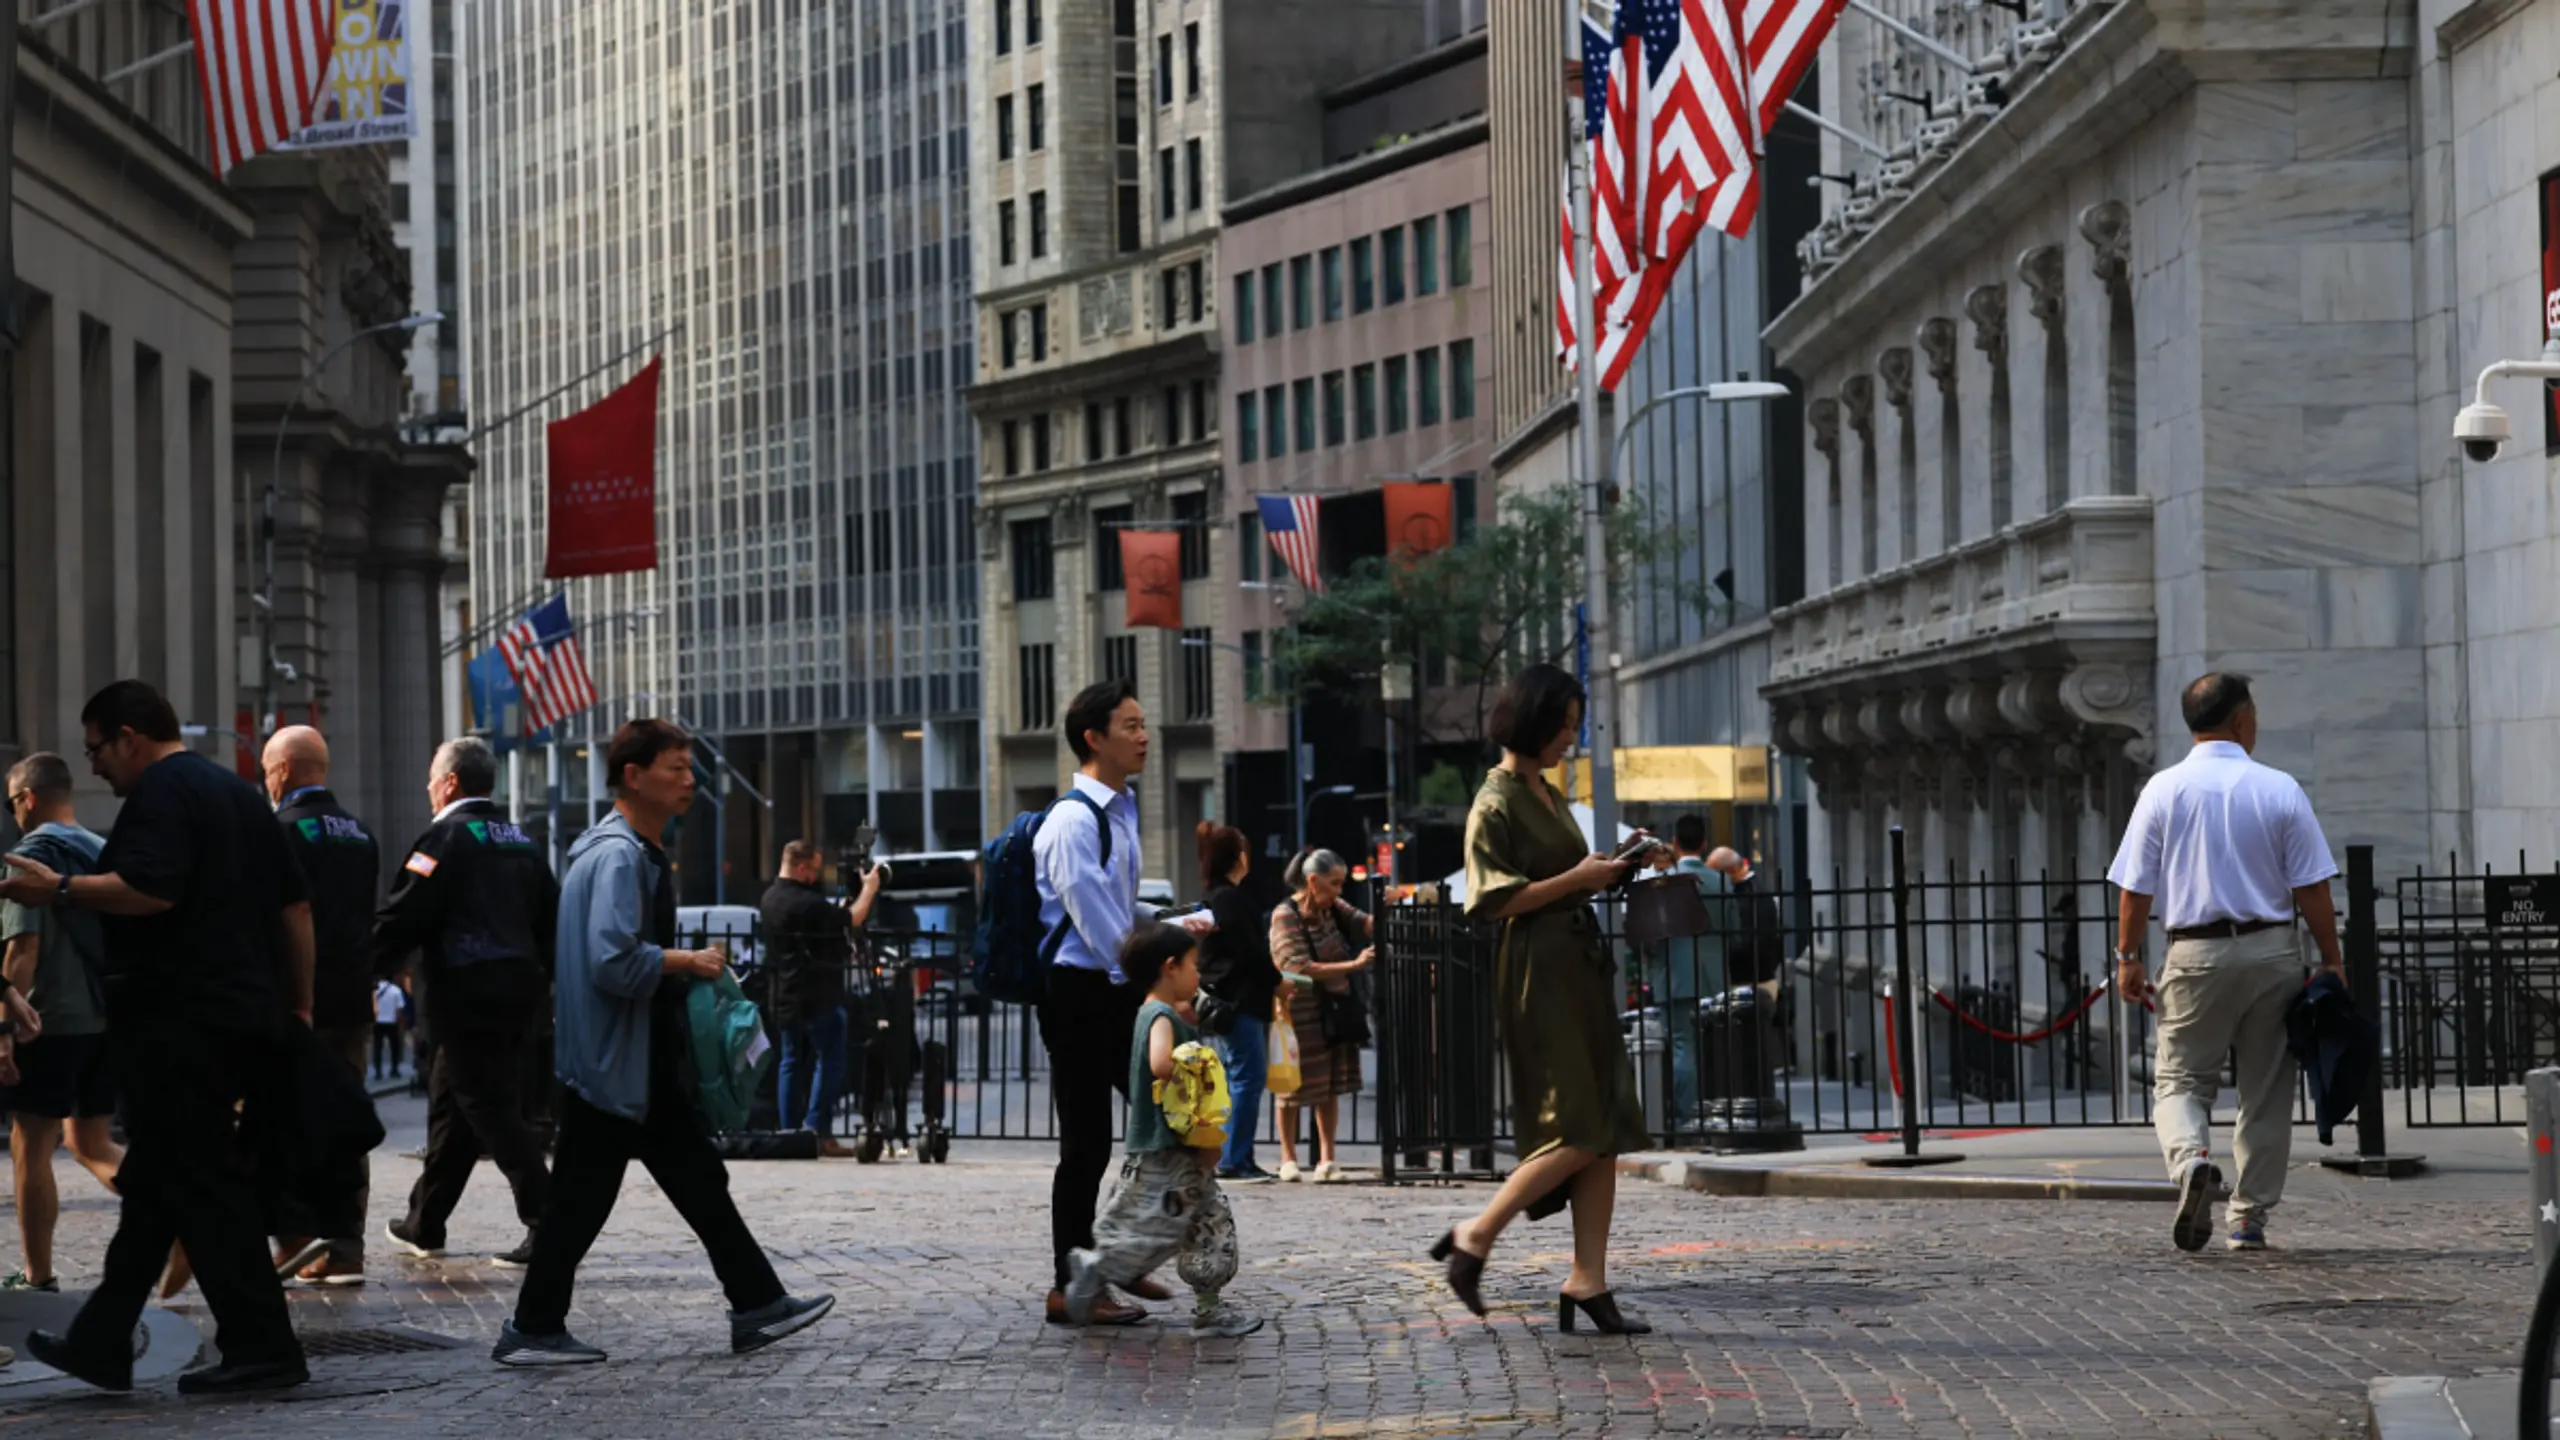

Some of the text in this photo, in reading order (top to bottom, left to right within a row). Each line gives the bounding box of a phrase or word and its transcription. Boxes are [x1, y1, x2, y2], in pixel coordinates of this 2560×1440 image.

[305, 124, 356, 144] Broad
[359, 121, 407, 139] Street
[2513, 900, 2534, 911] NO
[2502, 911, 2545, 924] ENTRY
